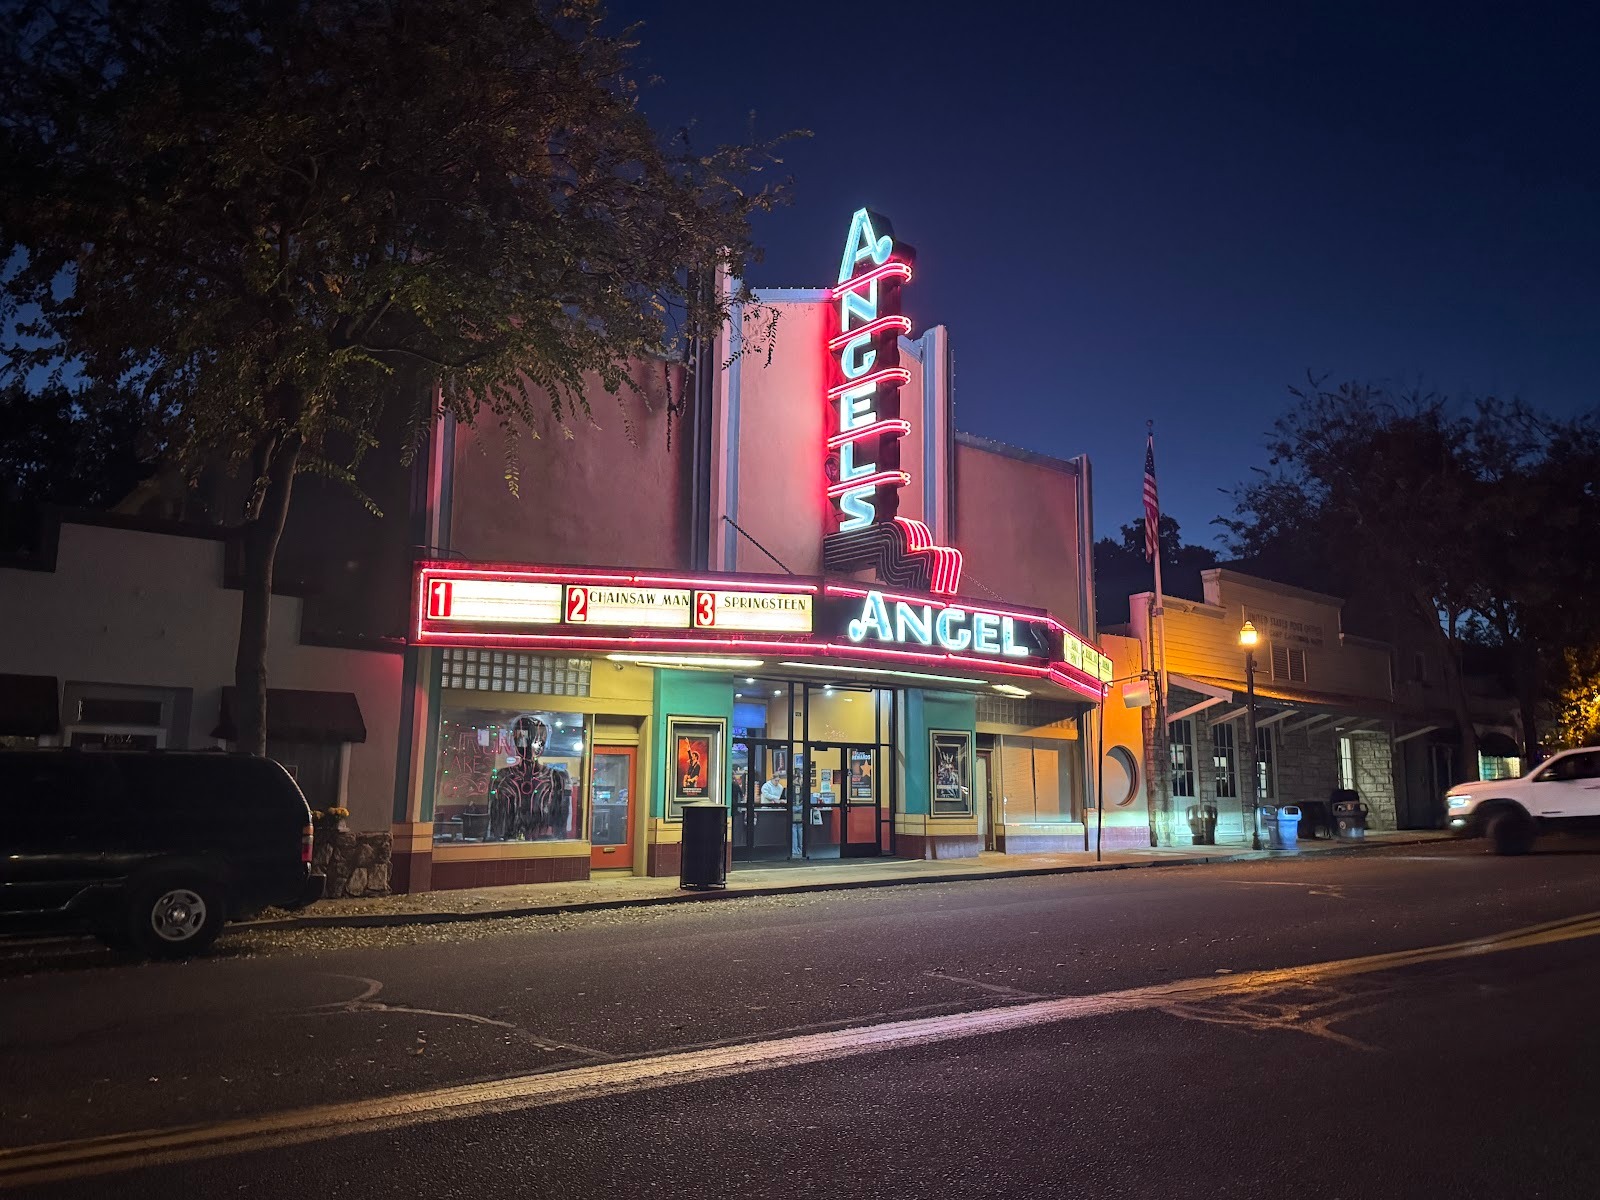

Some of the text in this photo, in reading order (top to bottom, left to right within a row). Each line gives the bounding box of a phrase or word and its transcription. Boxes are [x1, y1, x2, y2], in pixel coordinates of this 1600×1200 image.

[837, 207, 893, 532] ANGELS
[434, 582, 446, 616] 1
[570, 588, 690, 621] 2 CHAINSAW MAN
[698, 593, 806, 626] 3 SPRINGSTEEN
